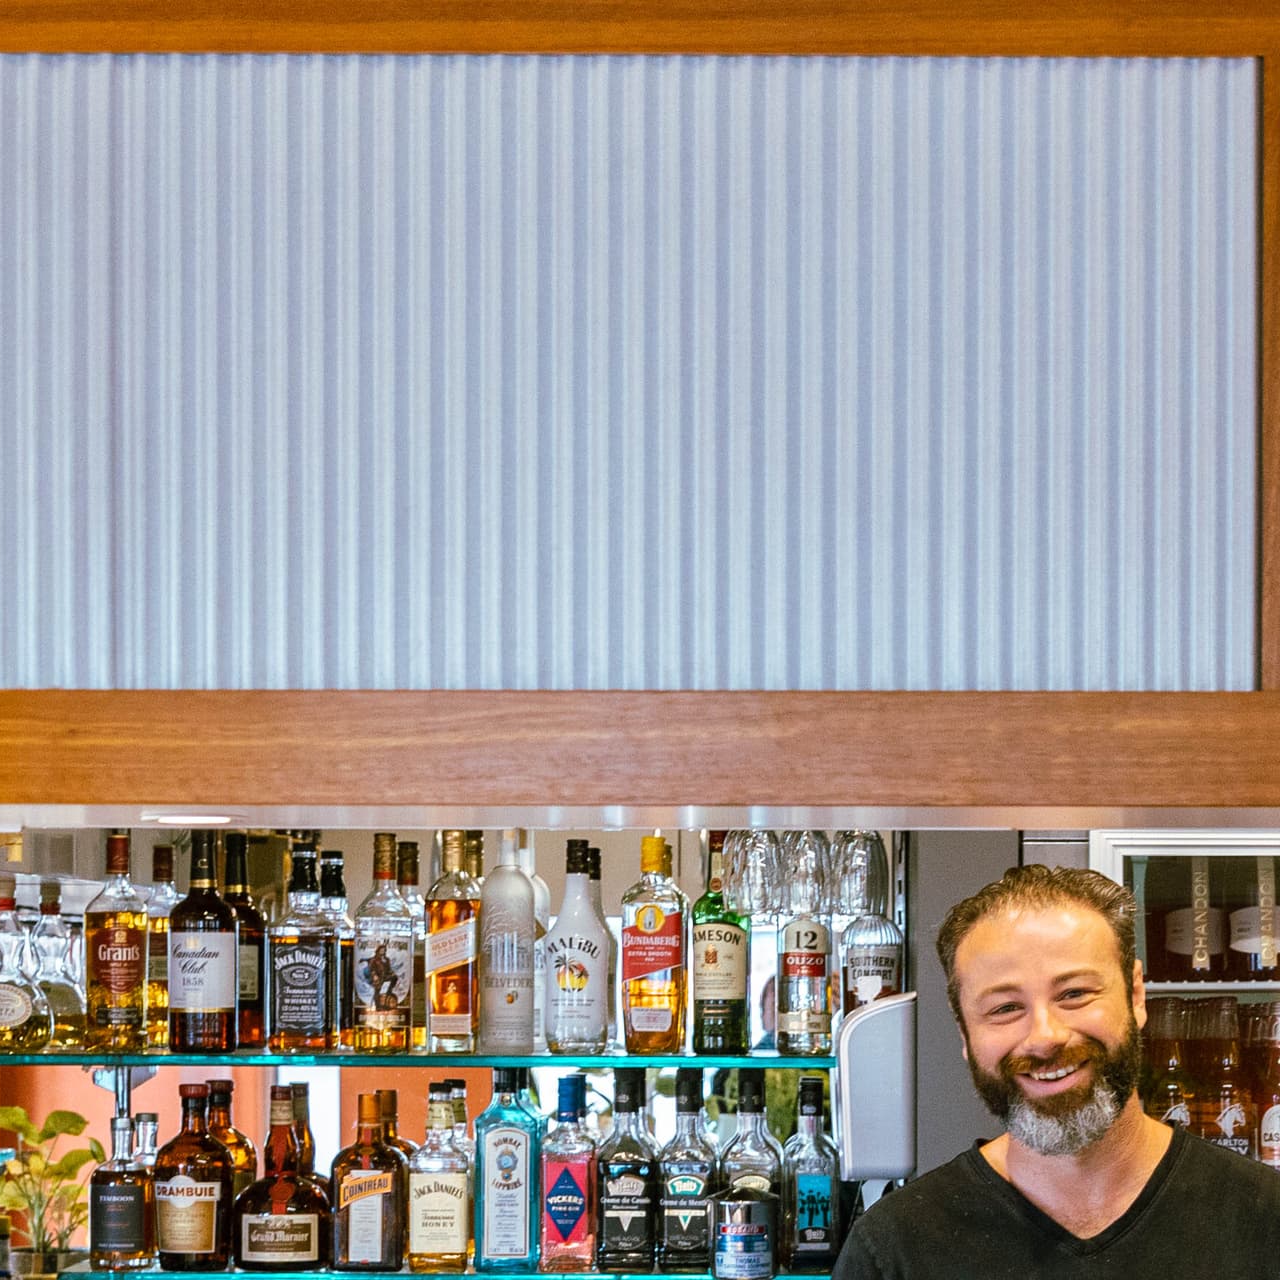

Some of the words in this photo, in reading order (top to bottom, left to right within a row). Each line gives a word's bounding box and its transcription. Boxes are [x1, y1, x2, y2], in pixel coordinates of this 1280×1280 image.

[1193, 872, 1208, 962] CHANDON
[622, 932, 680, 948] BUNDABERG
[693, 929, 741, 946] AMESON
[795, 930, 818, 950] 12
[172, 943, 220, 960] Canadian
[179, 959, 206, 975] Club
[274, 953, 294, 970] JACK
[786, 956, 824, 966] OUZO
[849, 956, 895, 969] SOUTHERN
[157, 1186, 215, 1197] DRAMBUIE
[342, 1176, 389, 1201] COINTREAU
[413, 1182, 433, 1200] JACK
